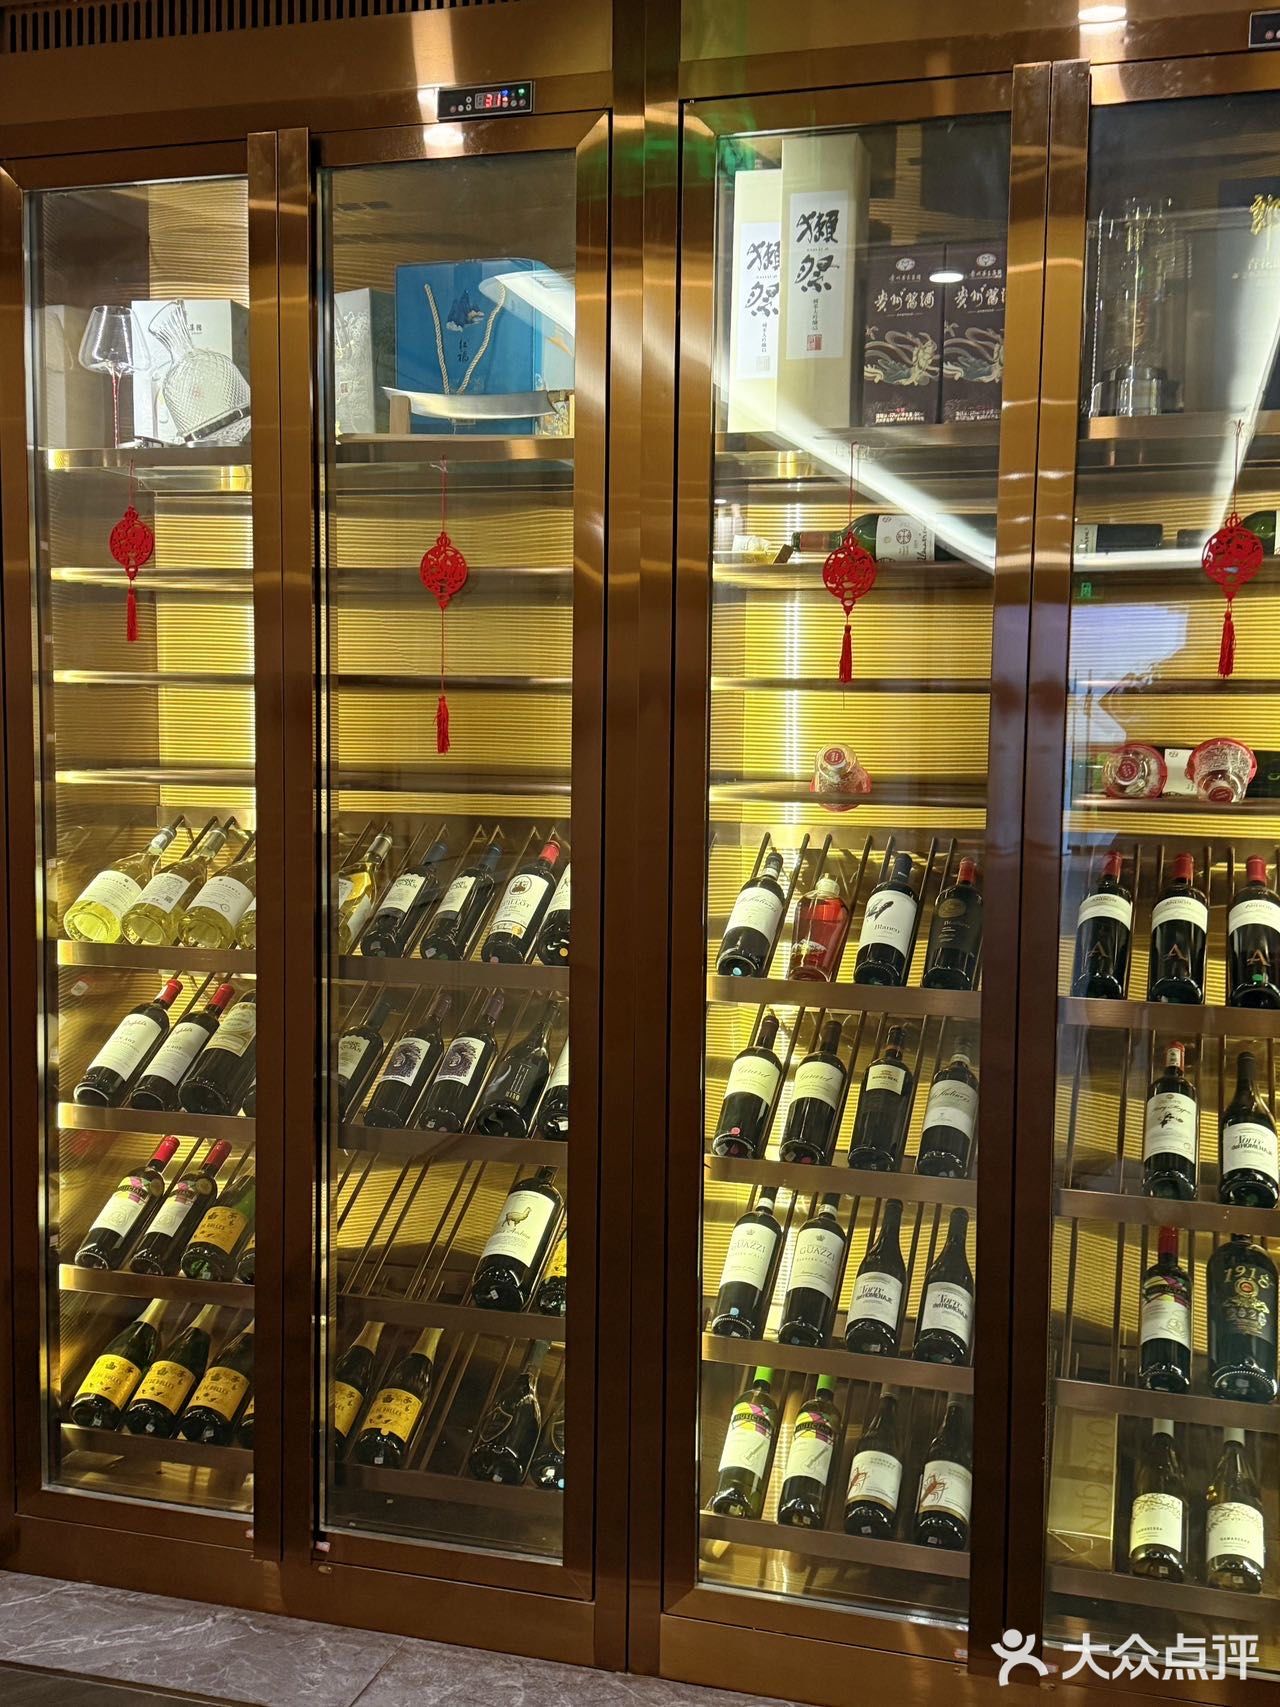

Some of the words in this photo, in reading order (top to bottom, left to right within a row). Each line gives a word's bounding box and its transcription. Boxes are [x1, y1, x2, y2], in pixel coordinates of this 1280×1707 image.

[1163, 944, 1188, 961] A
[1247, 949, 1271, 966] A
[799, 1244, 836, 1262] GUAZZI
